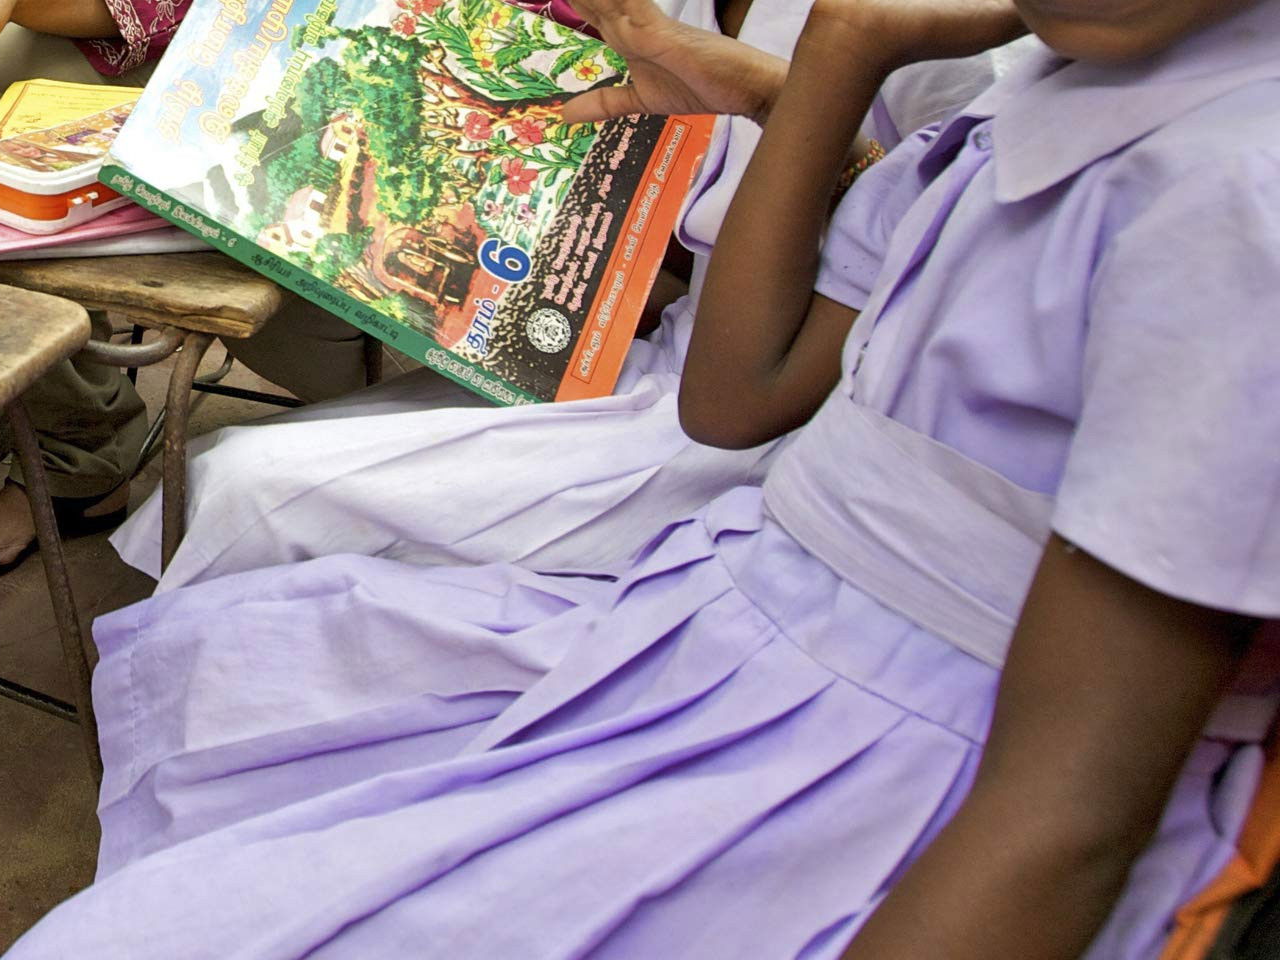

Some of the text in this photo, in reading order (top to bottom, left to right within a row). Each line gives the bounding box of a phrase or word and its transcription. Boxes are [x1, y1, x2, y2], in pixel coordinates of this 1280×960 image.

[155, 77, 202, 143] தமிழ்
[479, 238, 531, 283] 6
[250, 252, 291, 278] ஆசிரியர்
[353, 310, 398, 340] வழிகாட்டி
[466, 299, 496, 355] தரம்
